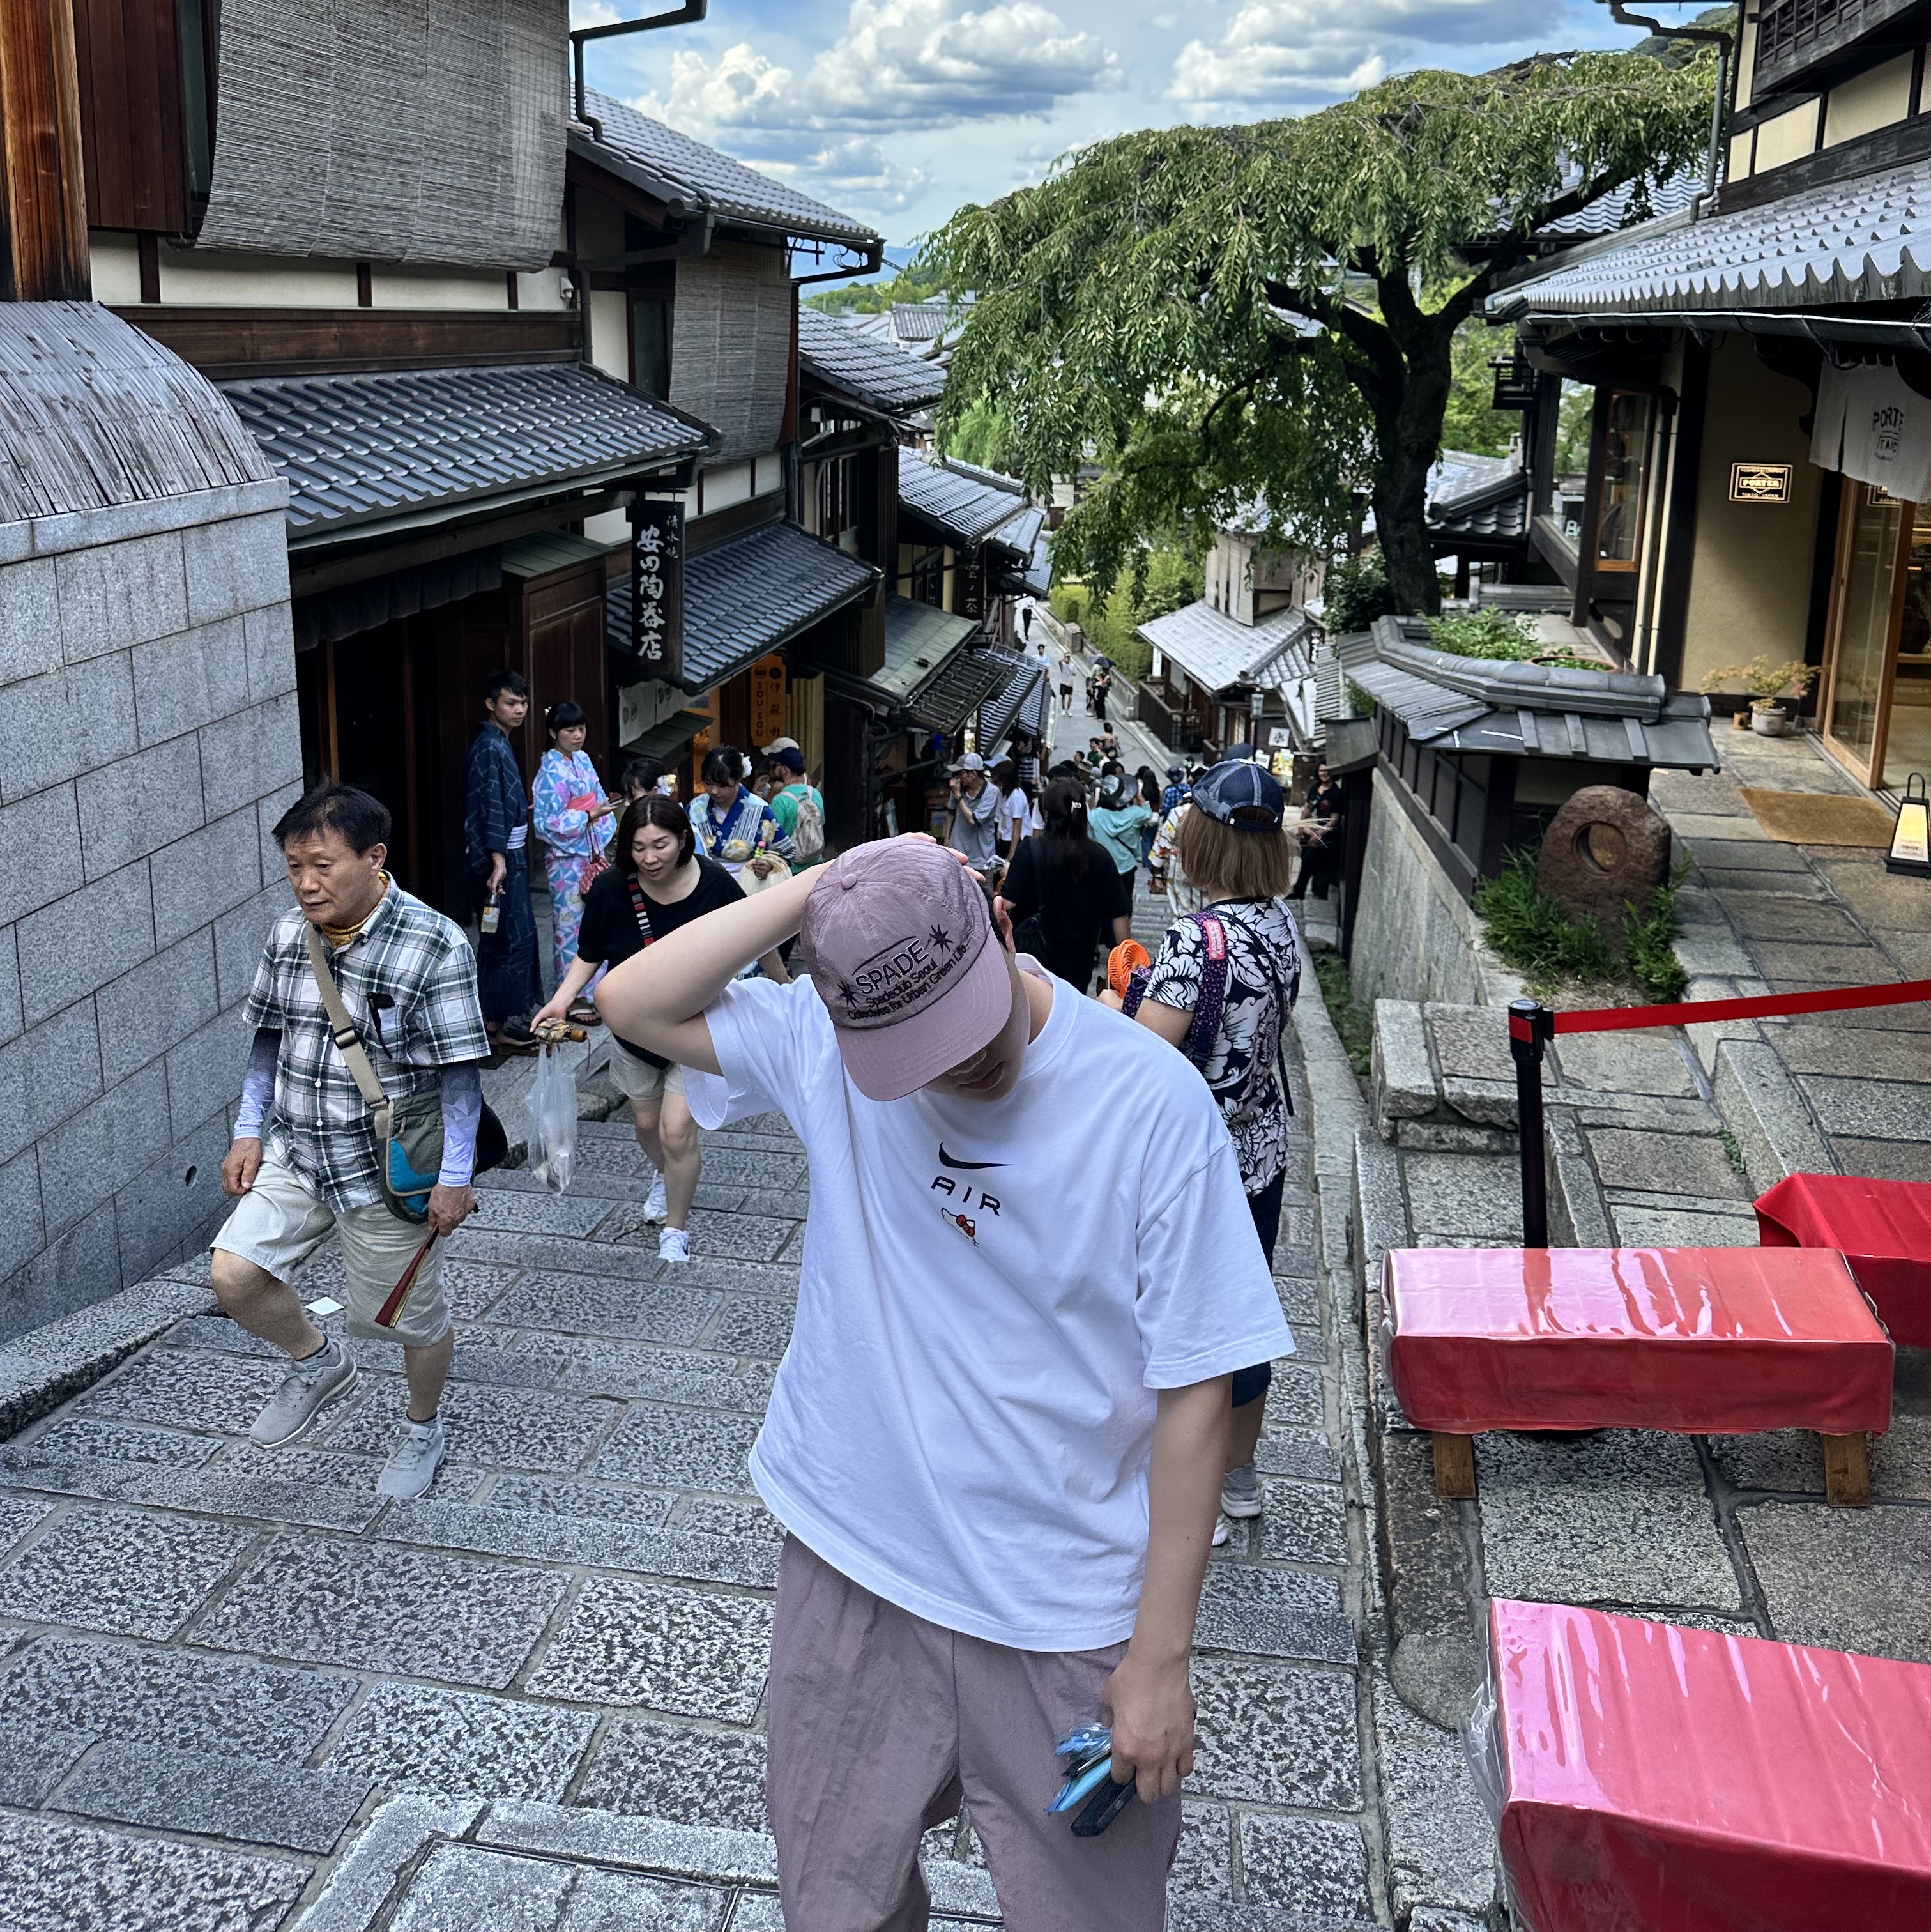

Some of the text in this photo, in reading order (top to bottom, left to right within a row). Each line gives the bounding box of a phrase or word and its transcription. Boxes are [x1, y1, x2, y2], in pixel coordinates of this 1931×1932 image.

[637, 525, 666, 660] 安田陶器店
[855, 939, 929, 995] SPADE
[866, 958, 938, 1008] Spadeclub Seoul
[889, 999, 903, 1011] for
[901, 982, 931, 1004] Urban
[929, 958, 957, 985] Green
[952, 944, 967, 962] Life
[931, 1176, 1000, 1216] AIR
